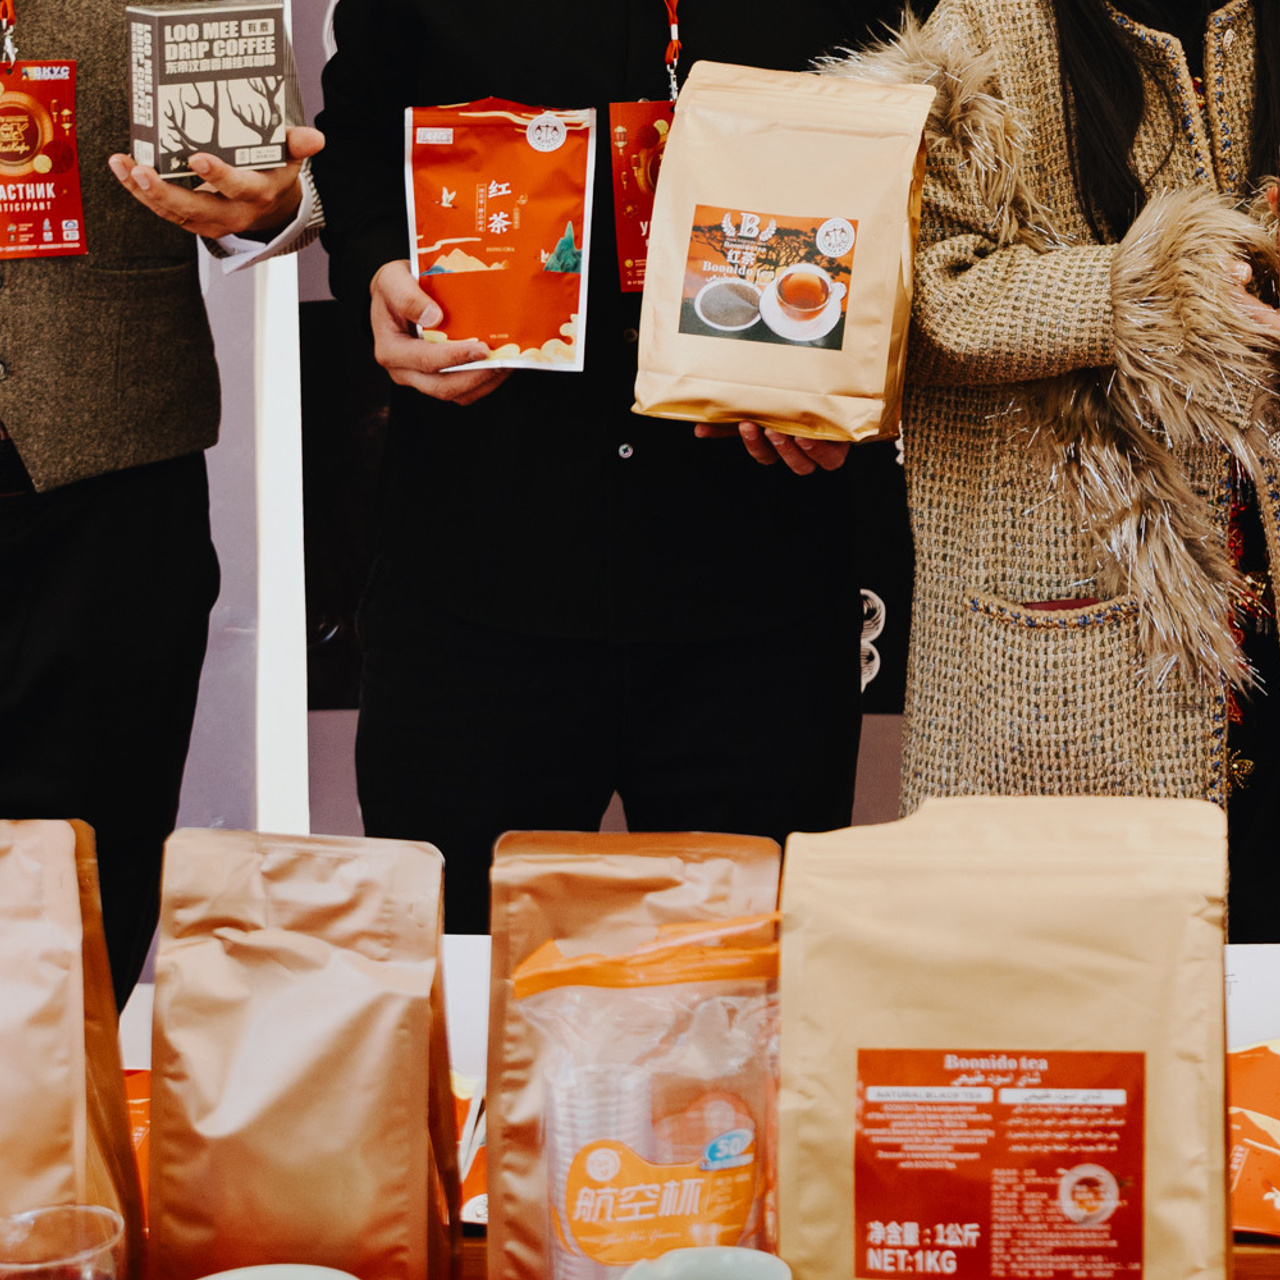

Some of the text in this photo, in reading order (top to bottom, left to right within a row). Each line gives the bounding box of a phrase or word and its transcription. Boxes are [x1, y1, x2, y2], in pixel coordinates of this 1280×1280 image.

[164, 23, 200, 43] LOO
[203, 21, 239, 40] MEE
[164, 36, 276, 61] DRIP COFFEE
[0, 201, 51, 212] TICIPANT
[487, 180, 512, 234] 红茶
[727, 249, 756, 266] 红茶
[944, 1054, 1048, 1070] Boonido tea
[717, 1137, 741, 1158] 50
[573, 1178, 704, 1222] 航空杯
